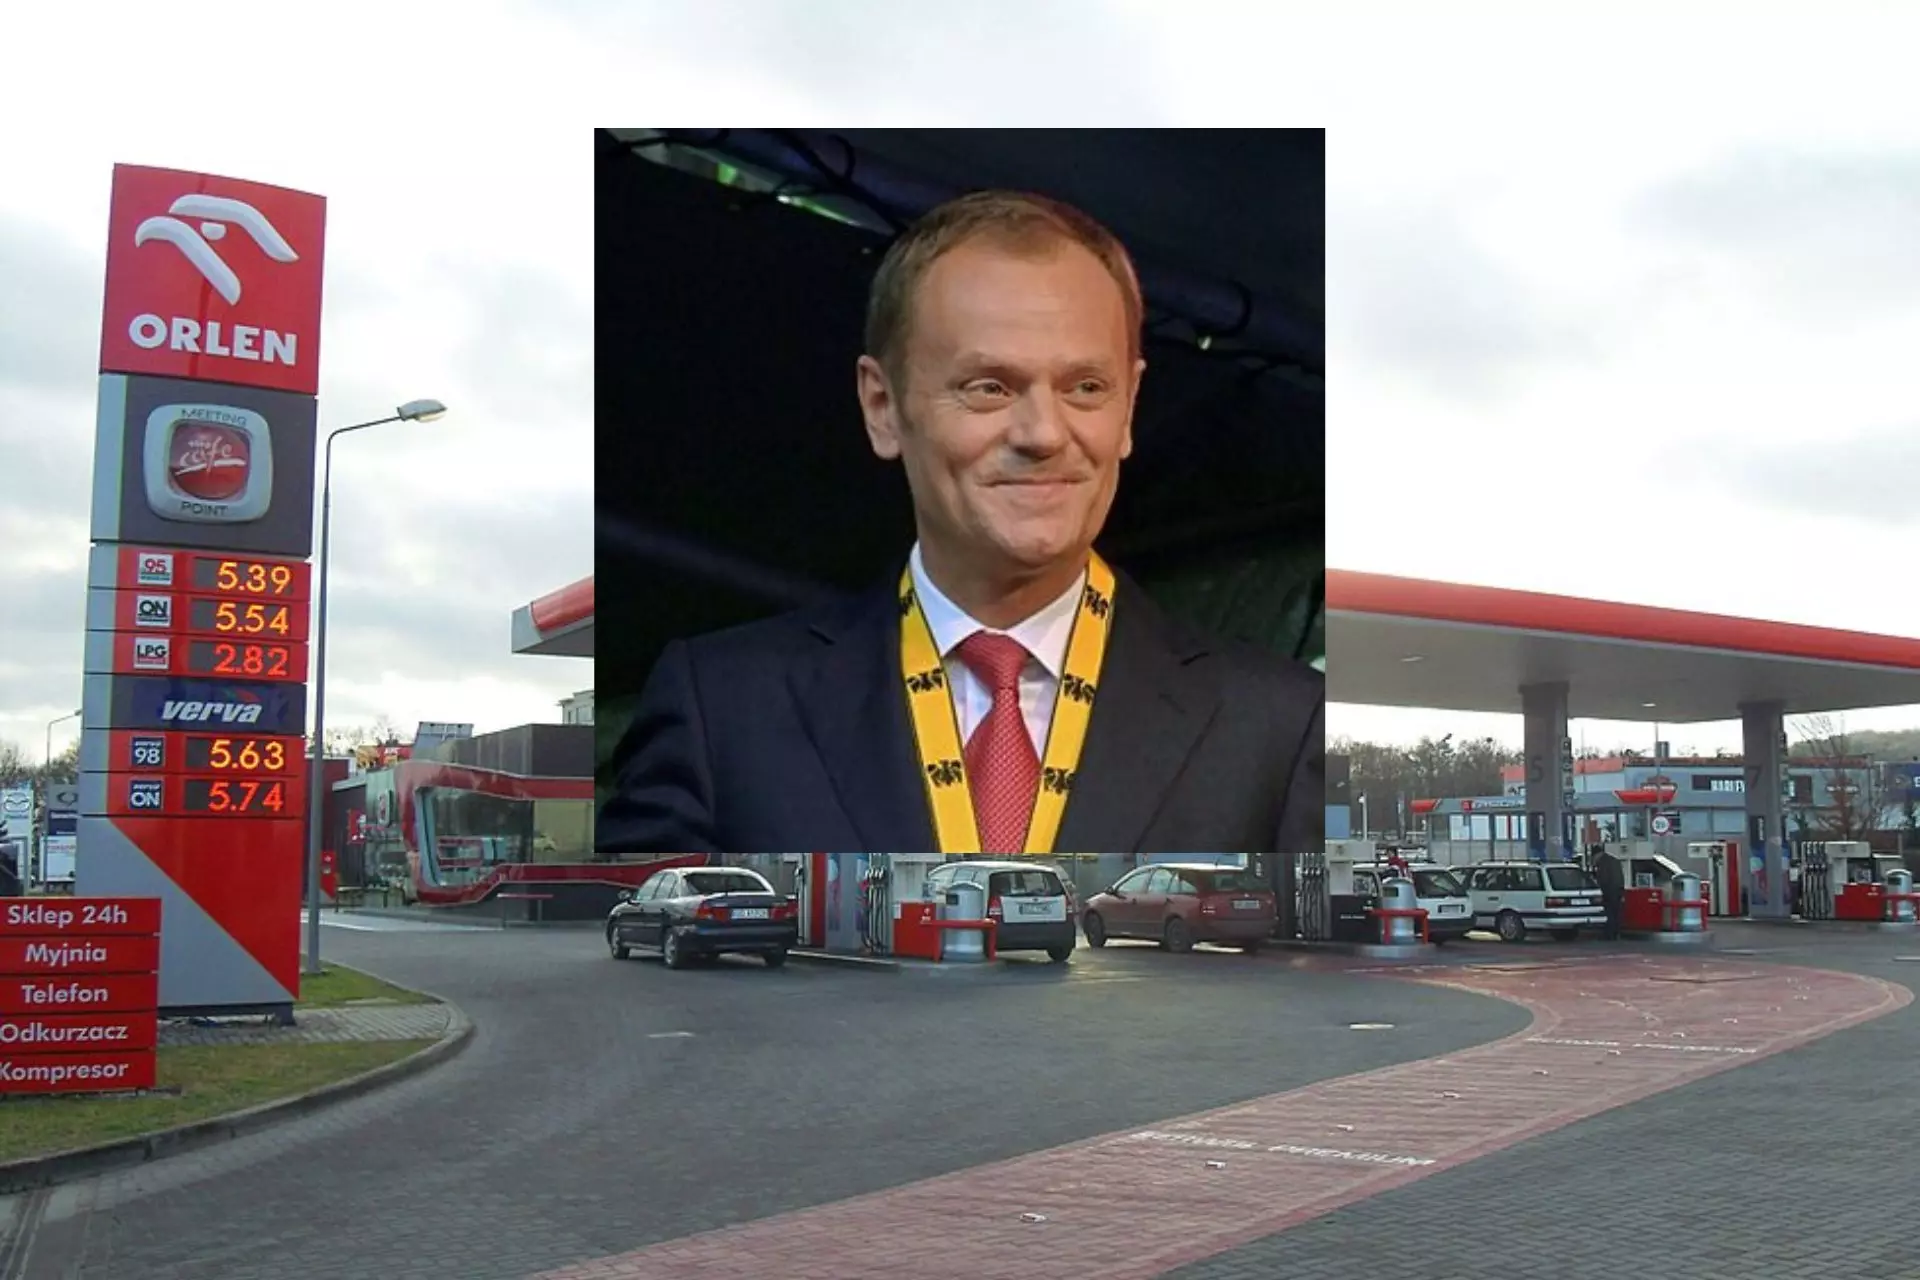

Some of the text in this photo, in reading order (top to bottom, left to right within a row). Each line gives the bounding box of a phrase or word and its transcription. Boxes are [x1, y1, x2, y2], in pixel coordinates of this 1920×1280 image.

[128, 313, 298, 366] ORLEN
[180, 408, 248, 426] MEETING
[180, 500, 229, 517] POINT
[144, 558, 291, 595] 95 5.39
[138, 599, 289, 636] ON 5.54
[136, 643, 289, 676] LPG 2.82
[161, 701, 263, 724] verva
[135, 739, 285, 771] 98 5.63
[1528, 756, 1546, 783] 5
[130, 781, 284, 812] ON 5.74
[7, 904, 128, 928] Sklep 24h
[24, 942, 108, 967] Myjnia
[21, 983, 109, 1004] Telefon
[0, 1022, 129, 1043] Odkurzacz
[0, 1062, 129, 1085] Kompresor
